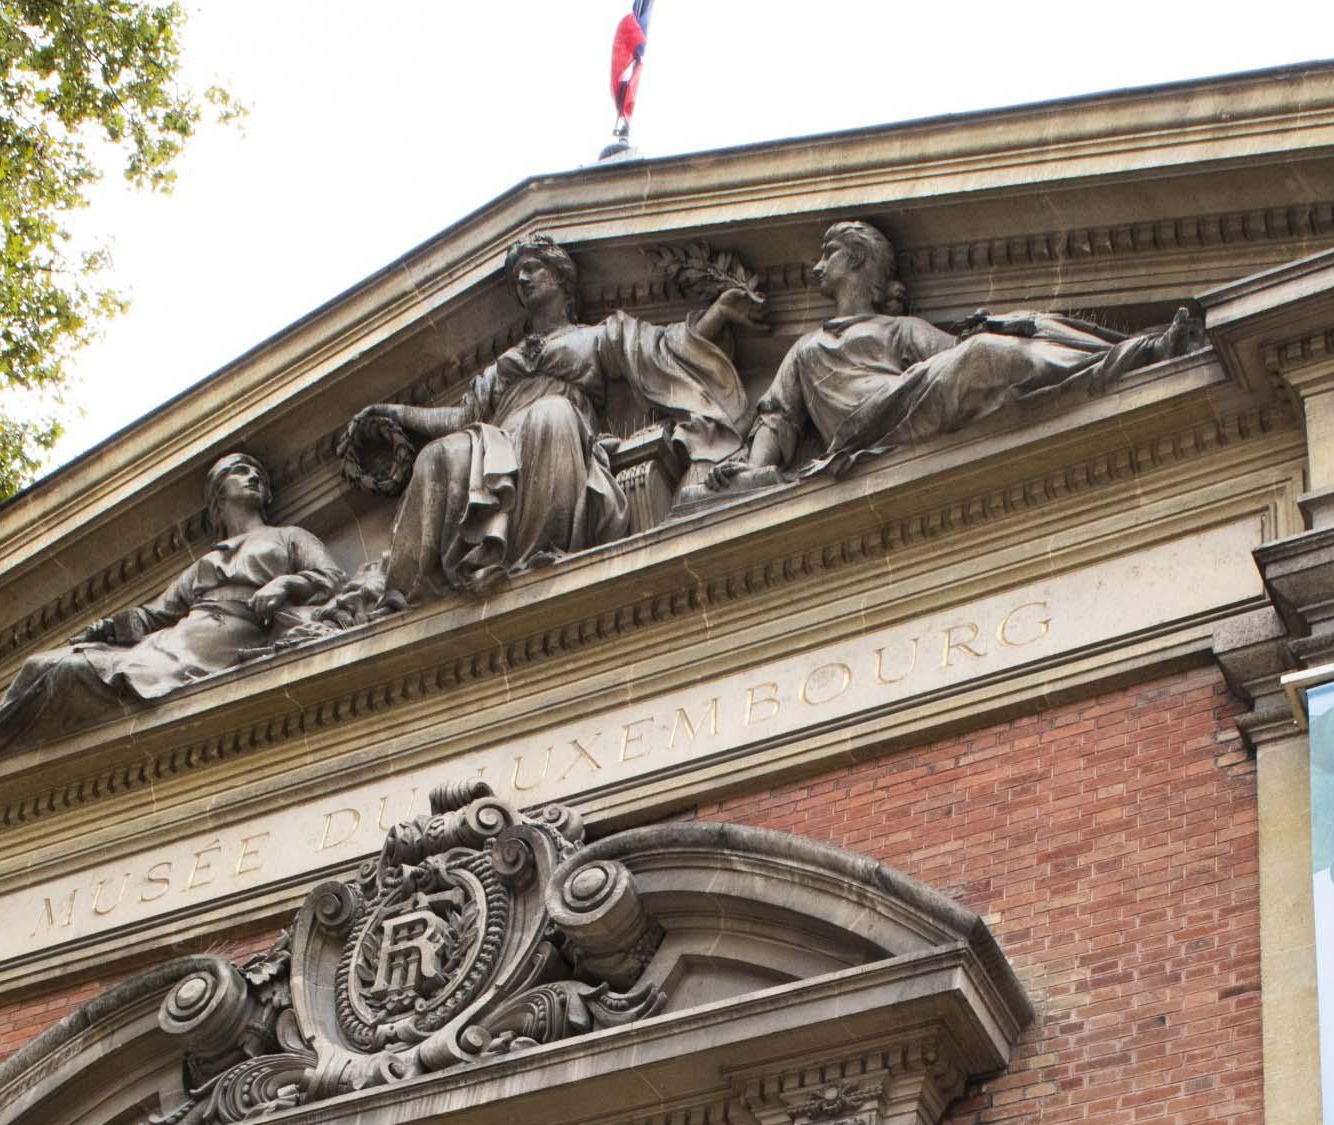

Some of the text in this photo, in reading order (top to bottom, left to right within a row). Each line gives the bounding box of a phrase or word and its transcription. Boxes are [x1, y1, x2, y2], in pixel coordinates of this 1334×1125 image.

[29, 600, 1054, 938] MUSÉE DU UXEMBOURG
